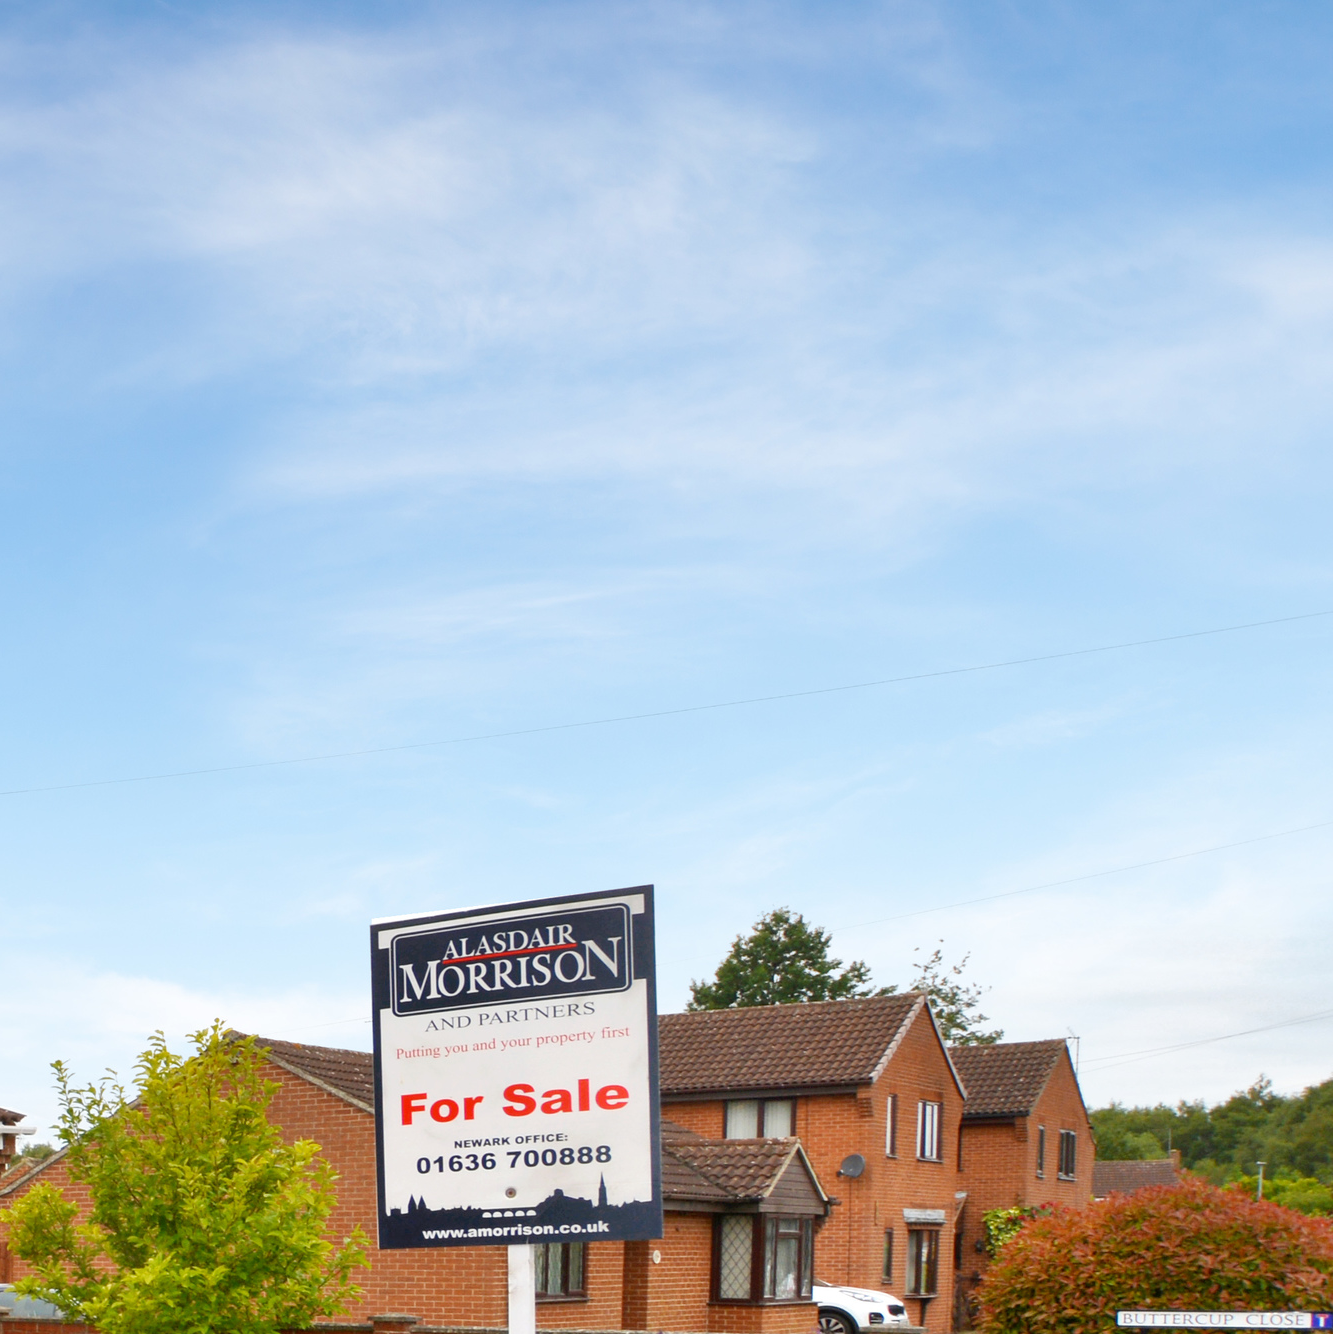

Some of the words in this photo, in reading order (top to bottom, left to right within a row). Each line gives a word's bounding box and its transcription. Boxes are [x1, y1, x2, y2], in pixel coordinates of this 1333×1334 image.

[442, 923, 576, 960] ALASDAIR
[399, 936, 623, 1003] MORRISON
[425, 1015, 471, 1032] AND
[479, 1002, 596, 1026] PARTNERS
[396, 1045, 441, 1060] Putting
[445, 1044, 469, 1057] you
[472, 1038, 496, 1051] and
[500, 1037, 532, 1051] your
[536, 1029, 596, 1048] property
[601, 1026, 630, 1039] first
[401, 1093, 484, 1126] For
[502, 1078, 630, 1118] Sale
[454, 1136, 510, 1149] NEWARK
[515, 1133, 568, 1145] OFFICE:
[416, 1152, 497, 1175] 01636
[506, 1144, 613, 1169] 700888
[422, 1220, 610, 1240] www.amorrison.co.uk
[1122, 1313, 1234, 1326] BUTTERCUP
[1245, 1313, 1305, 1326] CLOSE
